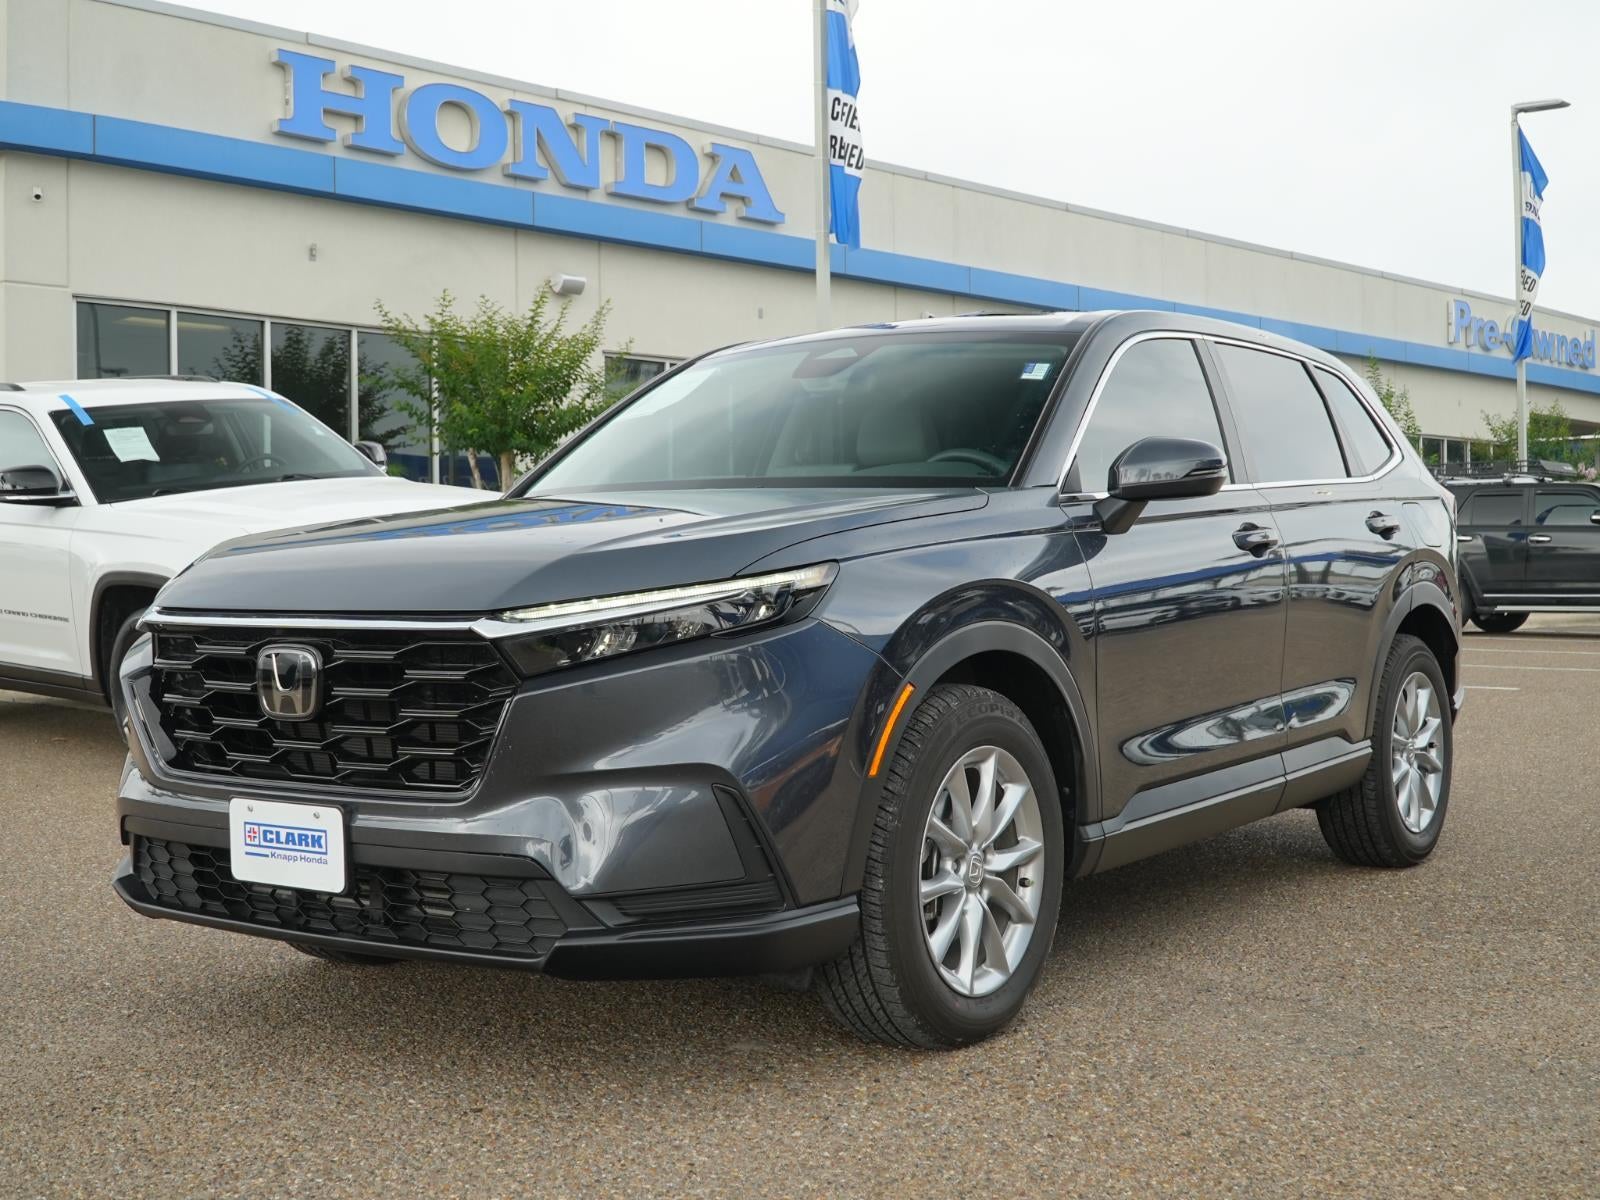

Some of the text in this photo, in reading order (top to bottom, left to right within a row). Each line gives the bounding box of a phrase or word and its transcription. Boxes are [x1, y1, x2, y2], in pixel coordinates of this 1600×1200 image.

[272, 49, 785, 225] HONDA
[262, 829, 324, 849] CLARK
[270, 851, 328, 865] Knapp Honda
